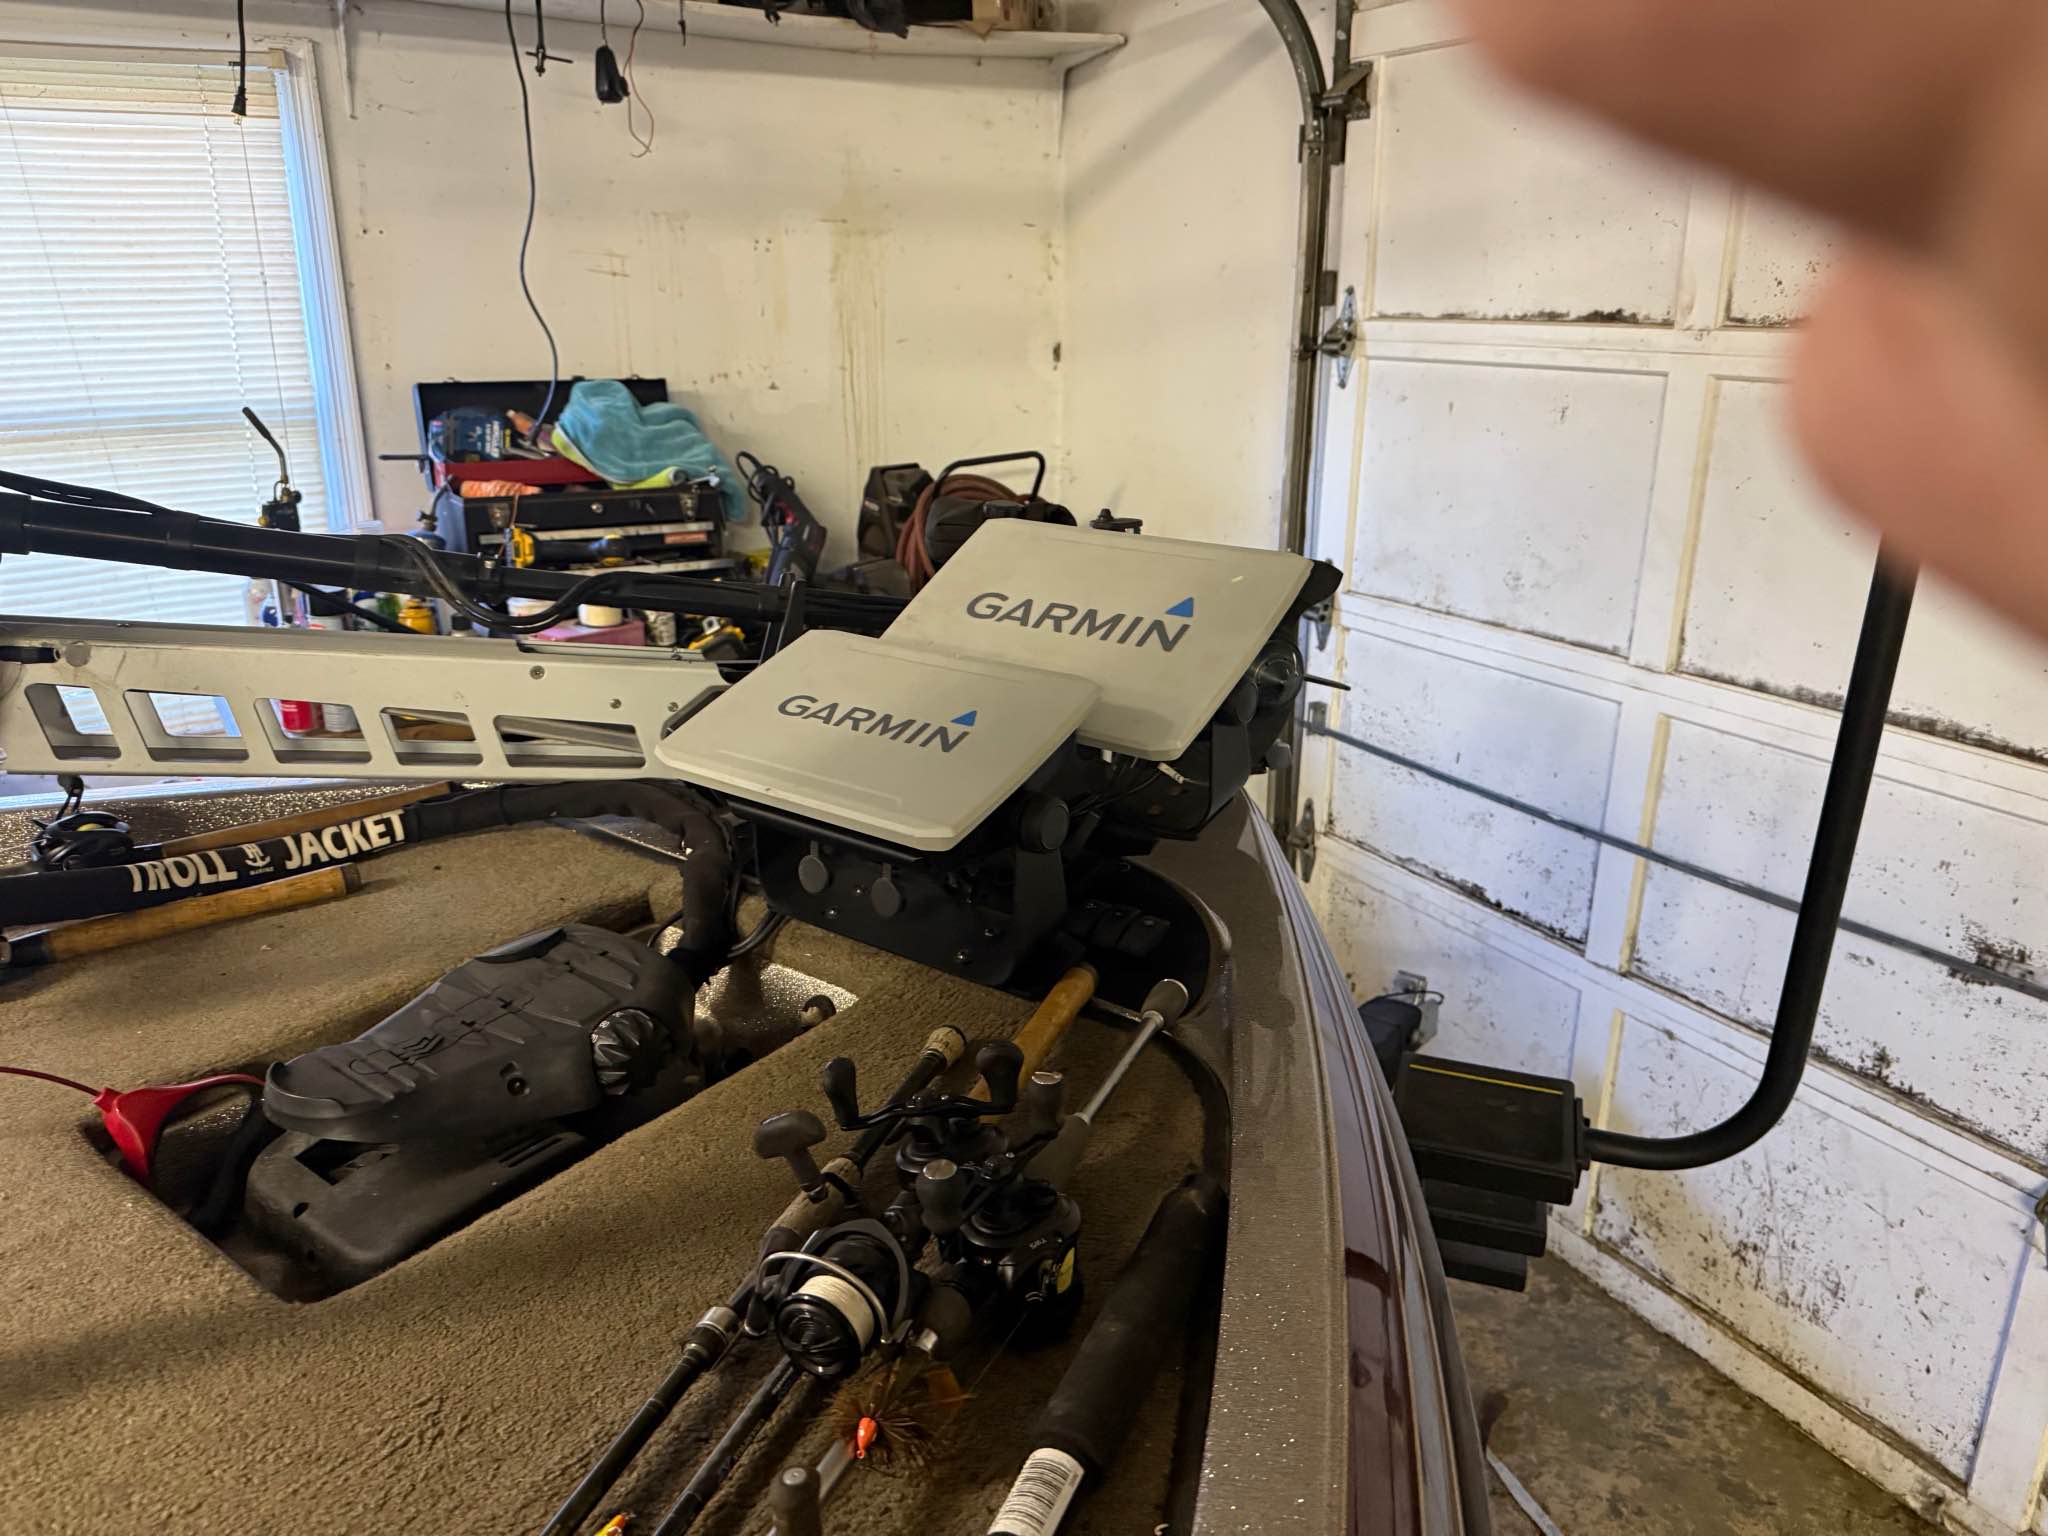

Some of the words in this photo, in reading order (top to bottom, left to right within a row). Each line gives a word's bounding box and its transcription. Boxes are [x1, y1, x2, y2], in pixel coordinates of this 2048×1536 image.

[966, 592, 1191, 652] GARMIN
[778, 695, 970, 752] GARMIN
[127, 850, 238, 892] TROLL
[282, 809, 405, 870] JACKET
